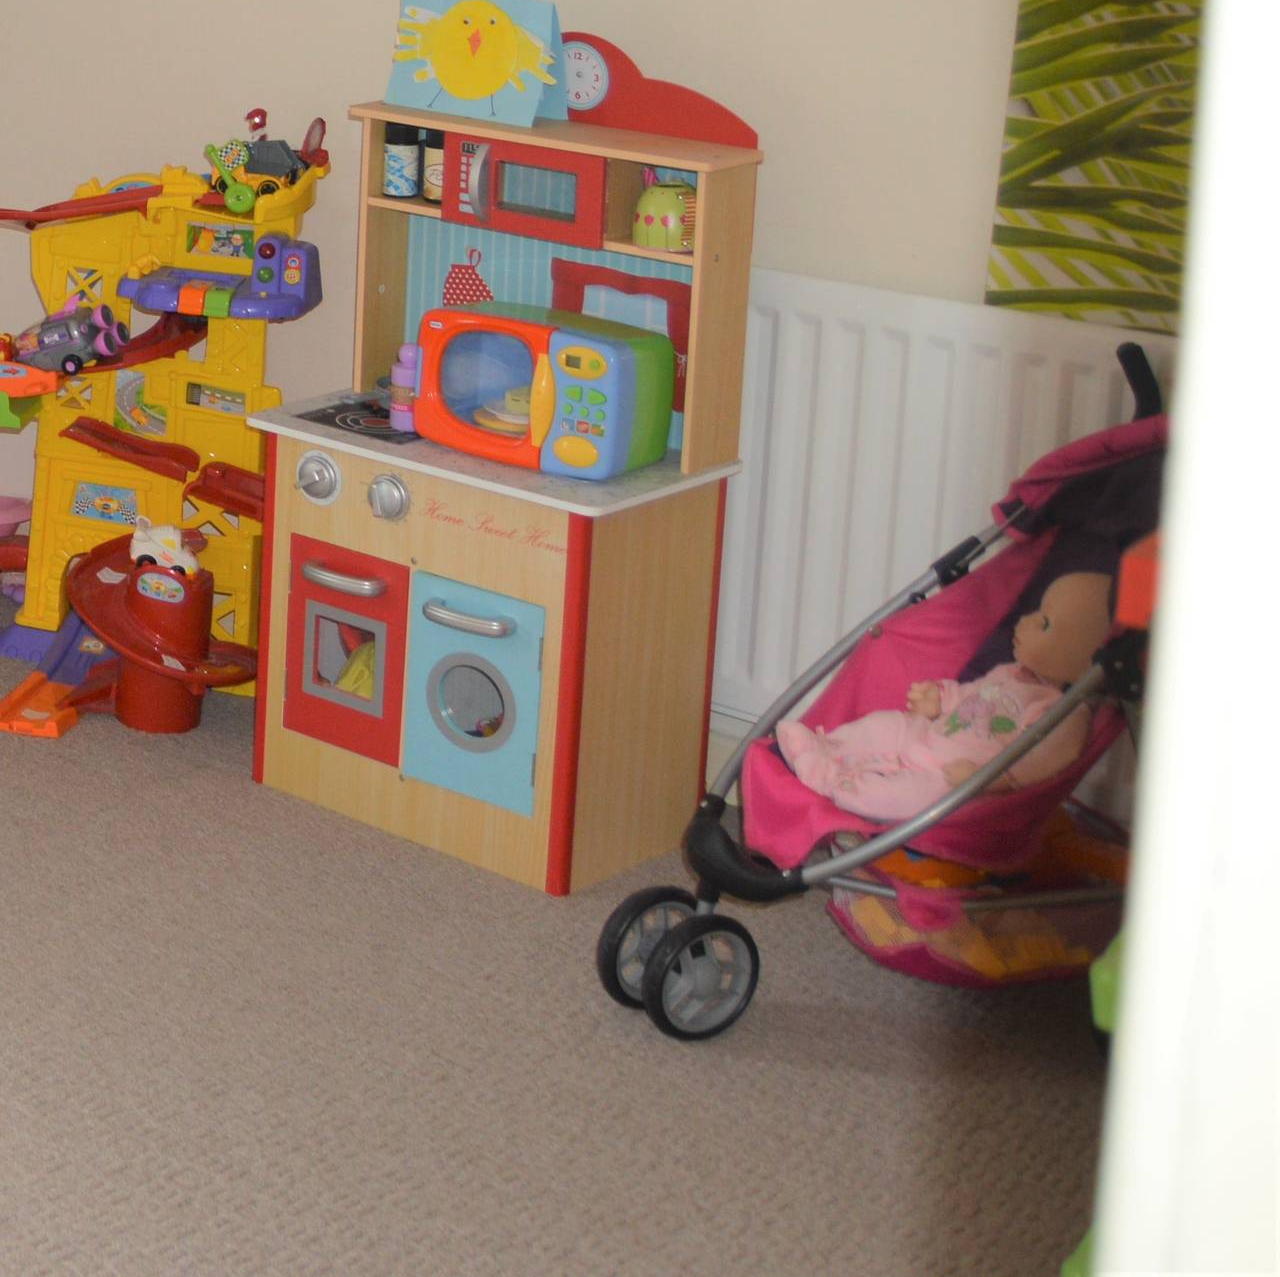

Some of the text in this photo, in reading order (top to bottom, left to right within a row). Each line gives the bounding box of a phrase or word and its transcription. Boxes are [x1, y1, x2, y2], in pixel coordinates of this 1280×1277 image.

[420, 498, 567, 554] Home Sweet Home
